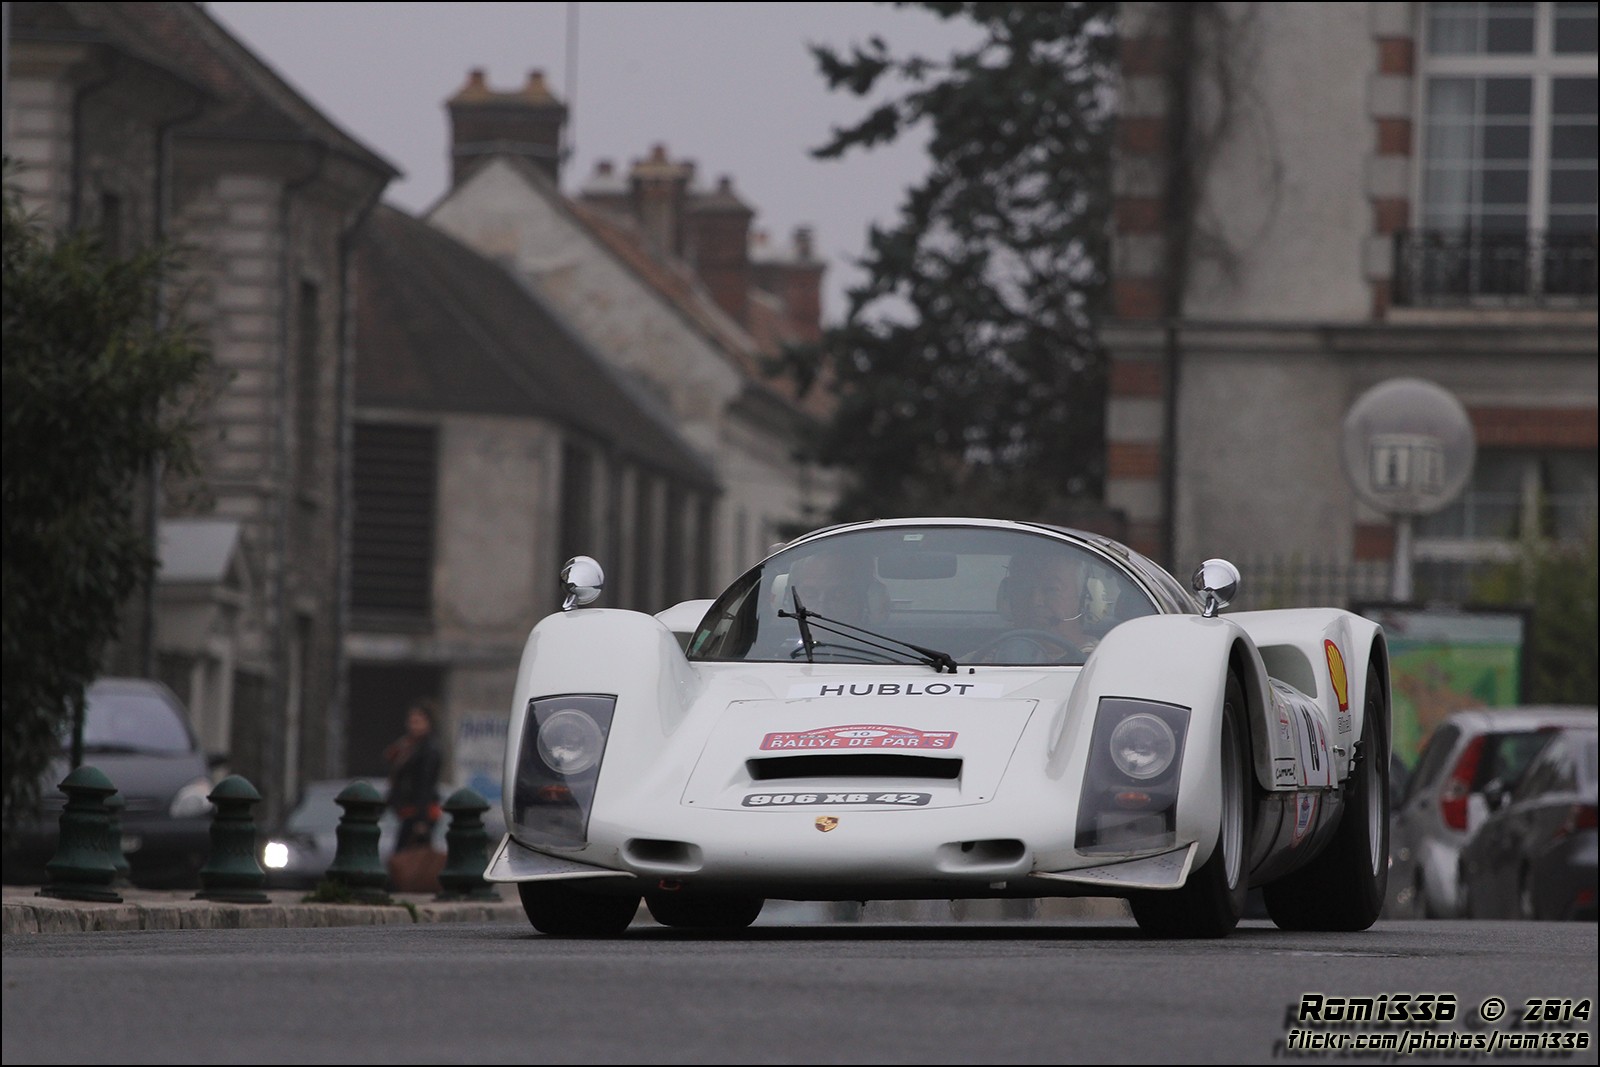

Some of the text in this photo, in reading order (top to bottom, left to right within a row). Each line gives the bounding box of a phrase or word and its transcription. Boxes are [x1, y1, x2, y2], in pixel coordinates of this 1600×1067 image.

[820, 684, 974, 696] HUBLOT
[771, 739, 839, 748] RALLYE
[848, 737, 873, 747] DE
[748, 793, 920, 805] 906 XB 42
